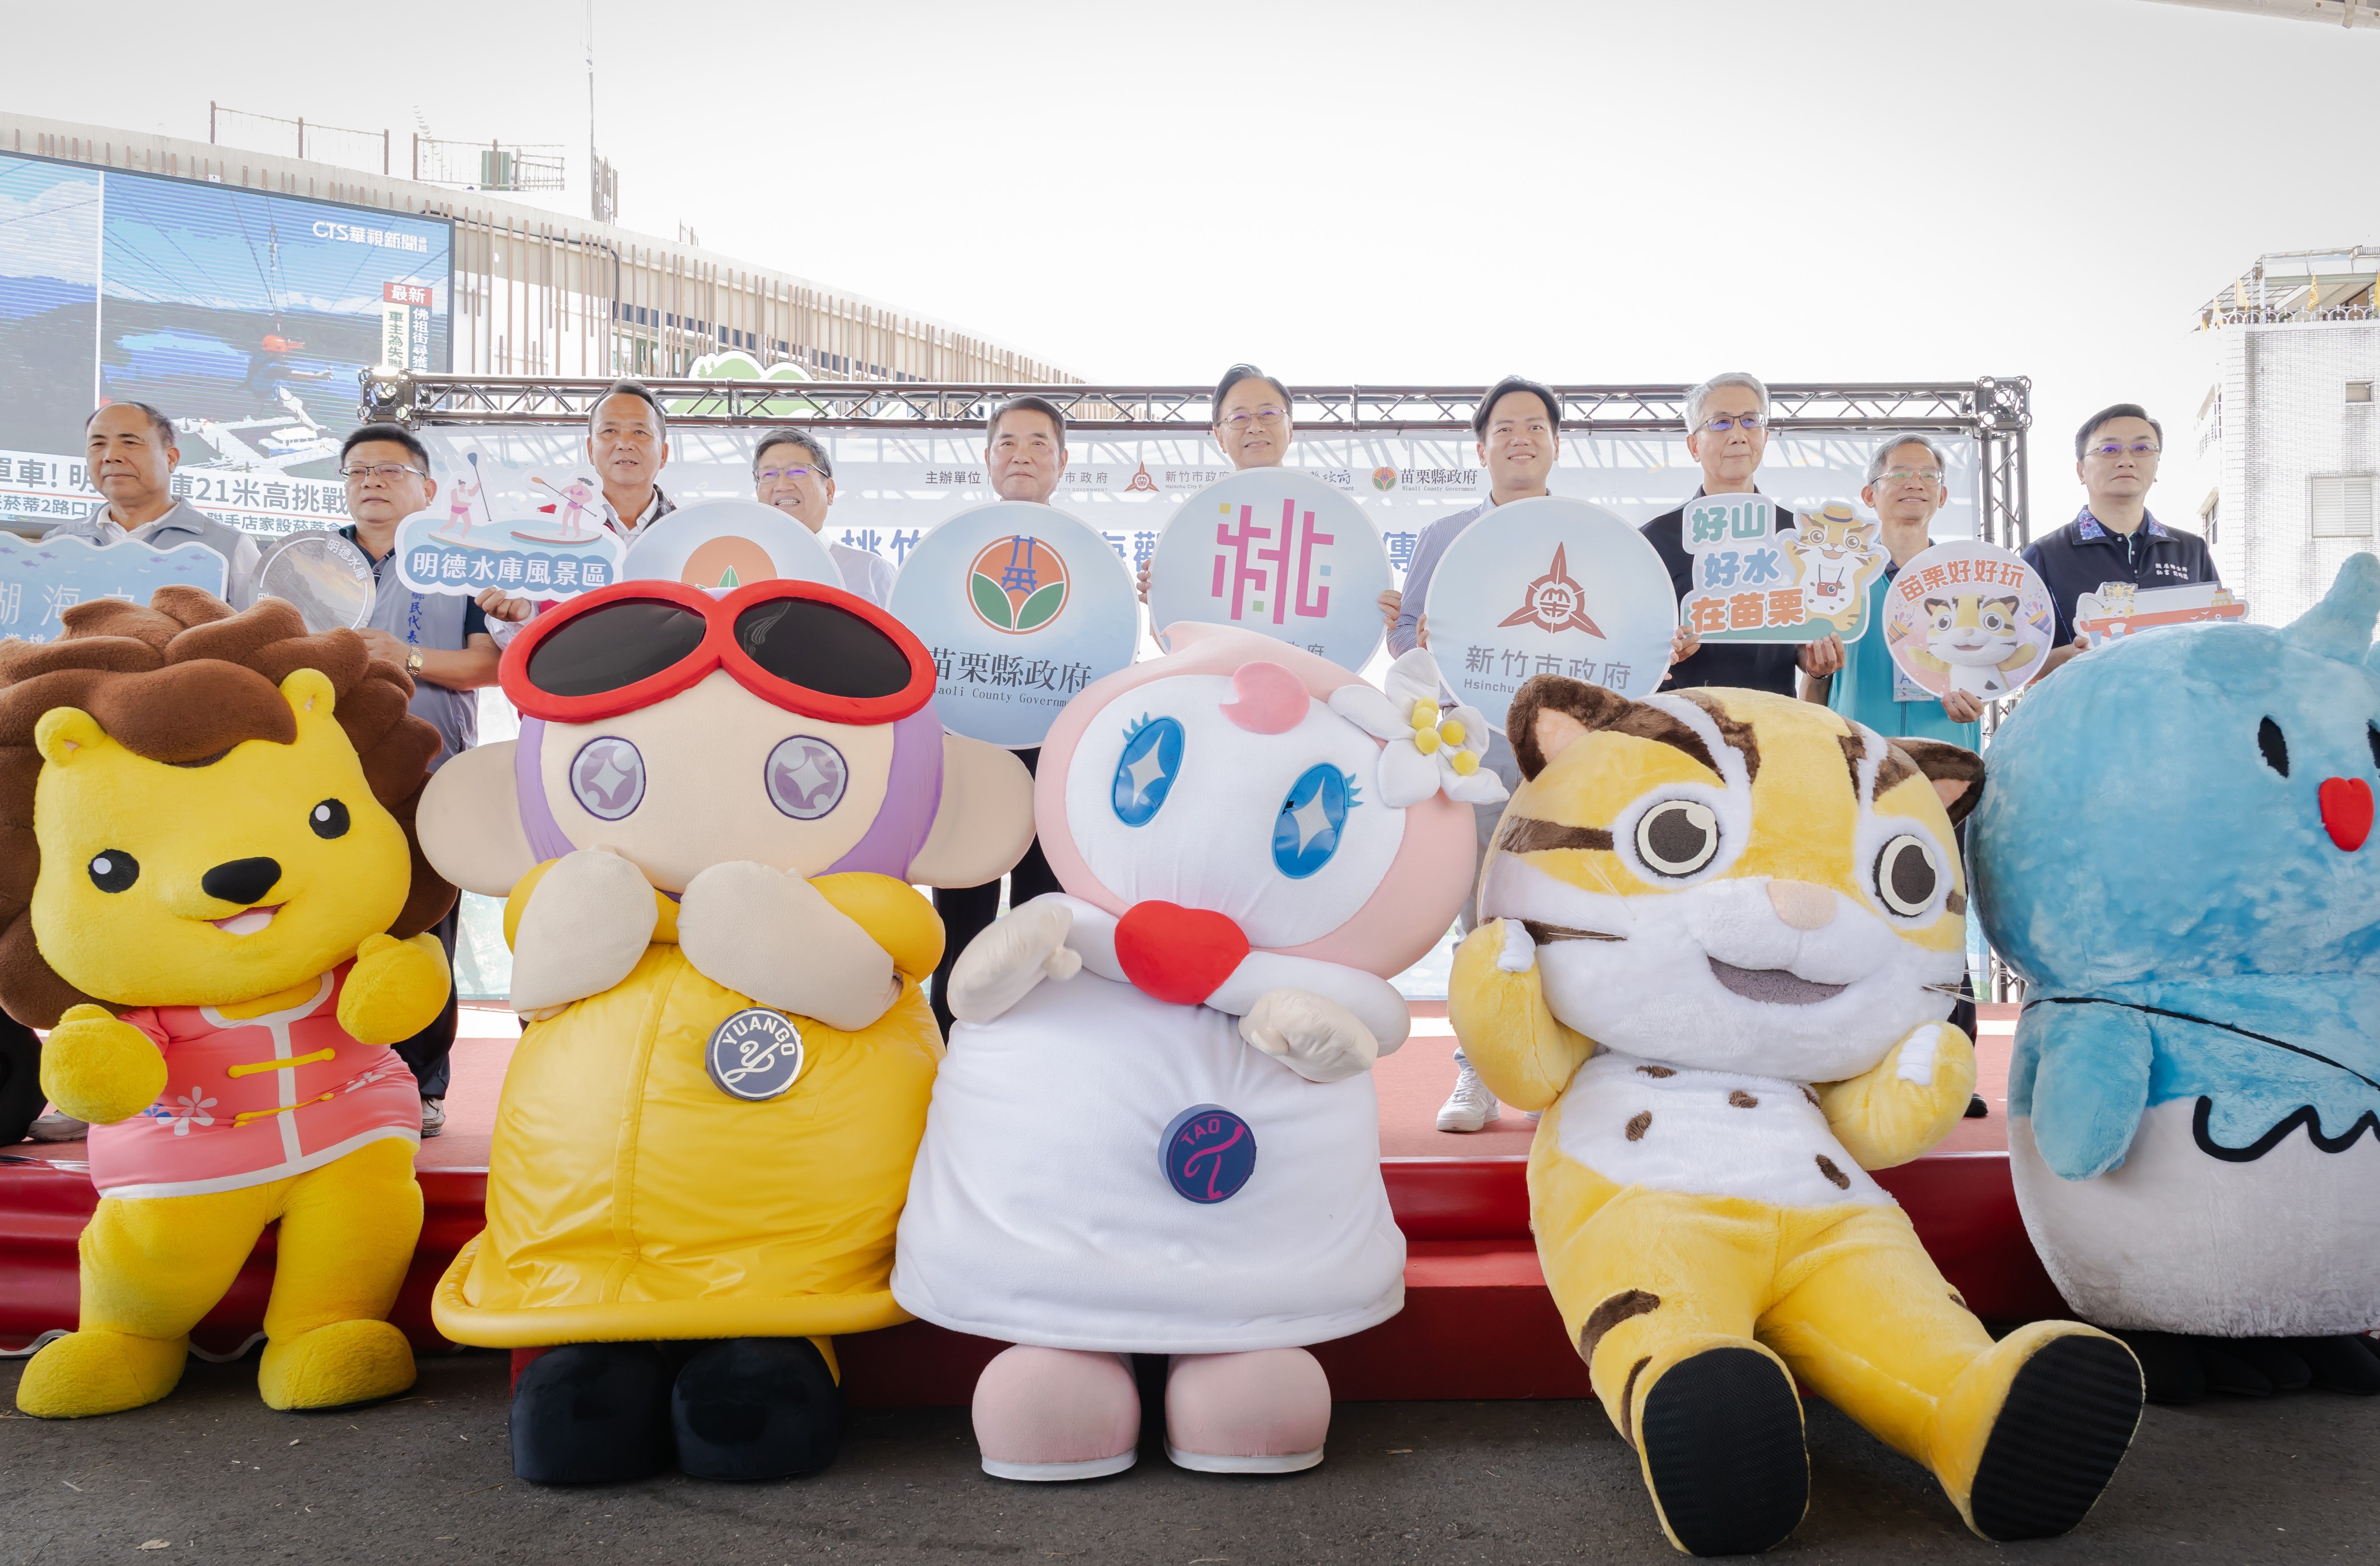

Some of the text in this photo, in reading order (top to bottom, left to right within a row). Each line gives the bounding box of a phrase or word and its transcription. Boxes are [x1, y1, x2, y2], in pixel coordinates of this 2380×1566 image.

[391, 285, 425, 304] 最新
[412, 308, 429, 372] 佛祖街尋獲
[925, 471, 981, 484] 主辦單位
[1058, 471, 1108, 483] 市政府
[1400, 468, 1477, 484] 苗栗縣政府
[0, 495, 104, 516] 菸蒂2路口
[1692, 503, 1766, 543] 好山
[327, 539, 368, 581] 明德水庫
[412, 552, 607, 587] 明德水庫風景區
[1704, 548, 1779, 588] 好水
[1896, 559, 2025, 603] 苗栗好好玩
[1690, 588, 1804, 633] 在苗栗
[929, 647, 1092, 693] 苗栗縣政府
[1465, 645, 1631, 689] 新竹市政府
[973, 688, 1012, 703] County
[1020, 693, 1069, 707] Governm
[1464, 678, 1514, 694] Hsinchu
[722, 1016, 795, 1055] YUANGO
[1180, 1118, 1220, 1146] TAO
